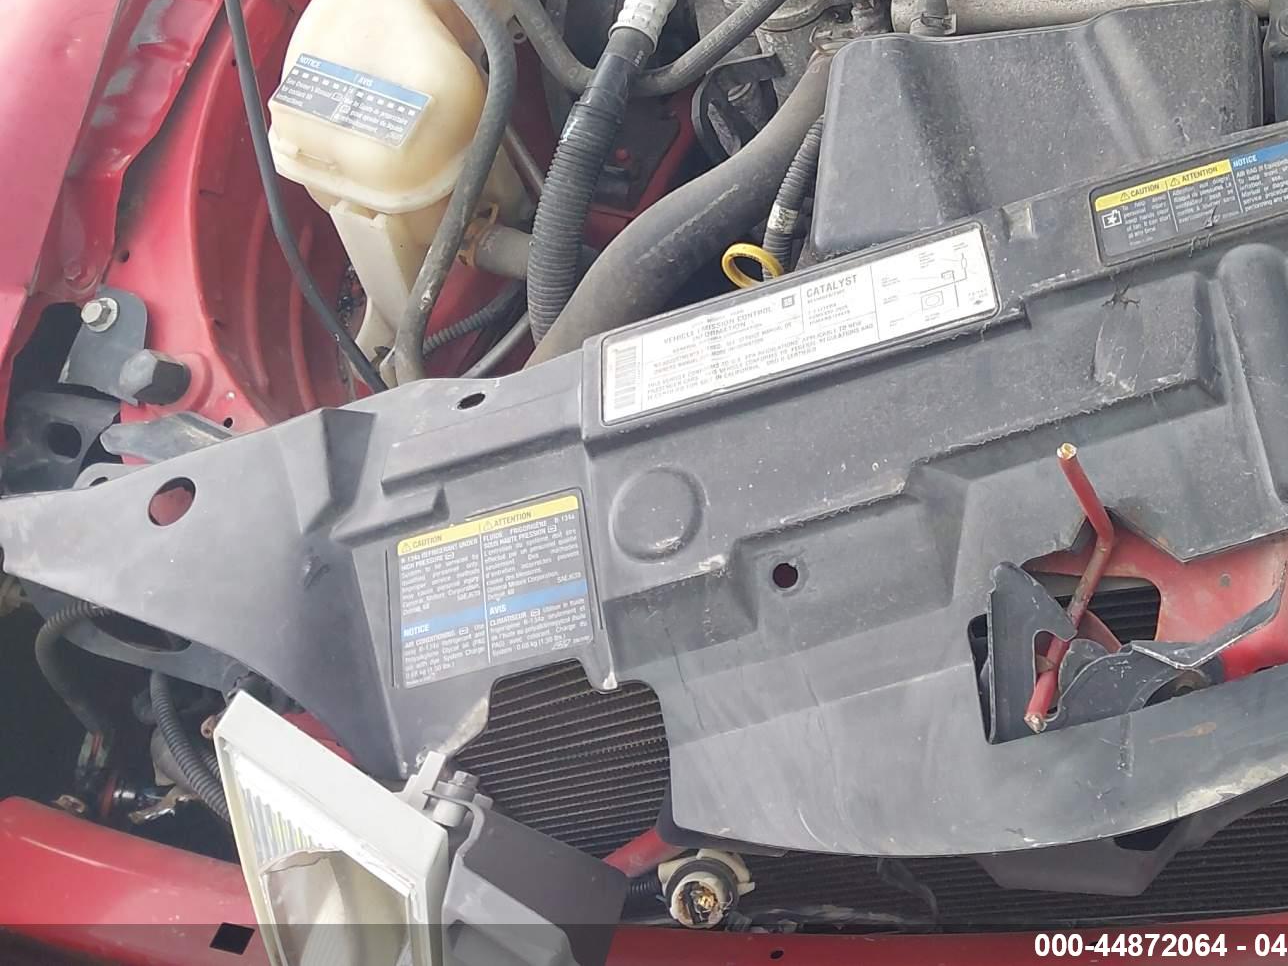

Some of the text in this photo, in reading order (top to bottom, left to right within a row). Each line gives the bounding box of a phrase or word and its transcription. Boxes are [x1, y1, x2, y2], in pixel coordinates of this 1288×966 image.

[1232, 155, 1257, 167] NOTICE
[1182, 166, 1218, 182] ATTENTION
[1130, 184, 1159, 197] CAUTION
[806, 274, 857, 298] CATALYST
[664, 329, 693, 344] VEHICLE
[493, 513, 531, 527] ATTENTION
[412, 536, 441, 548] CAUTION
[489, 605, 506, 615] AVIS
[403, 624, 430, 637] NOTICE
